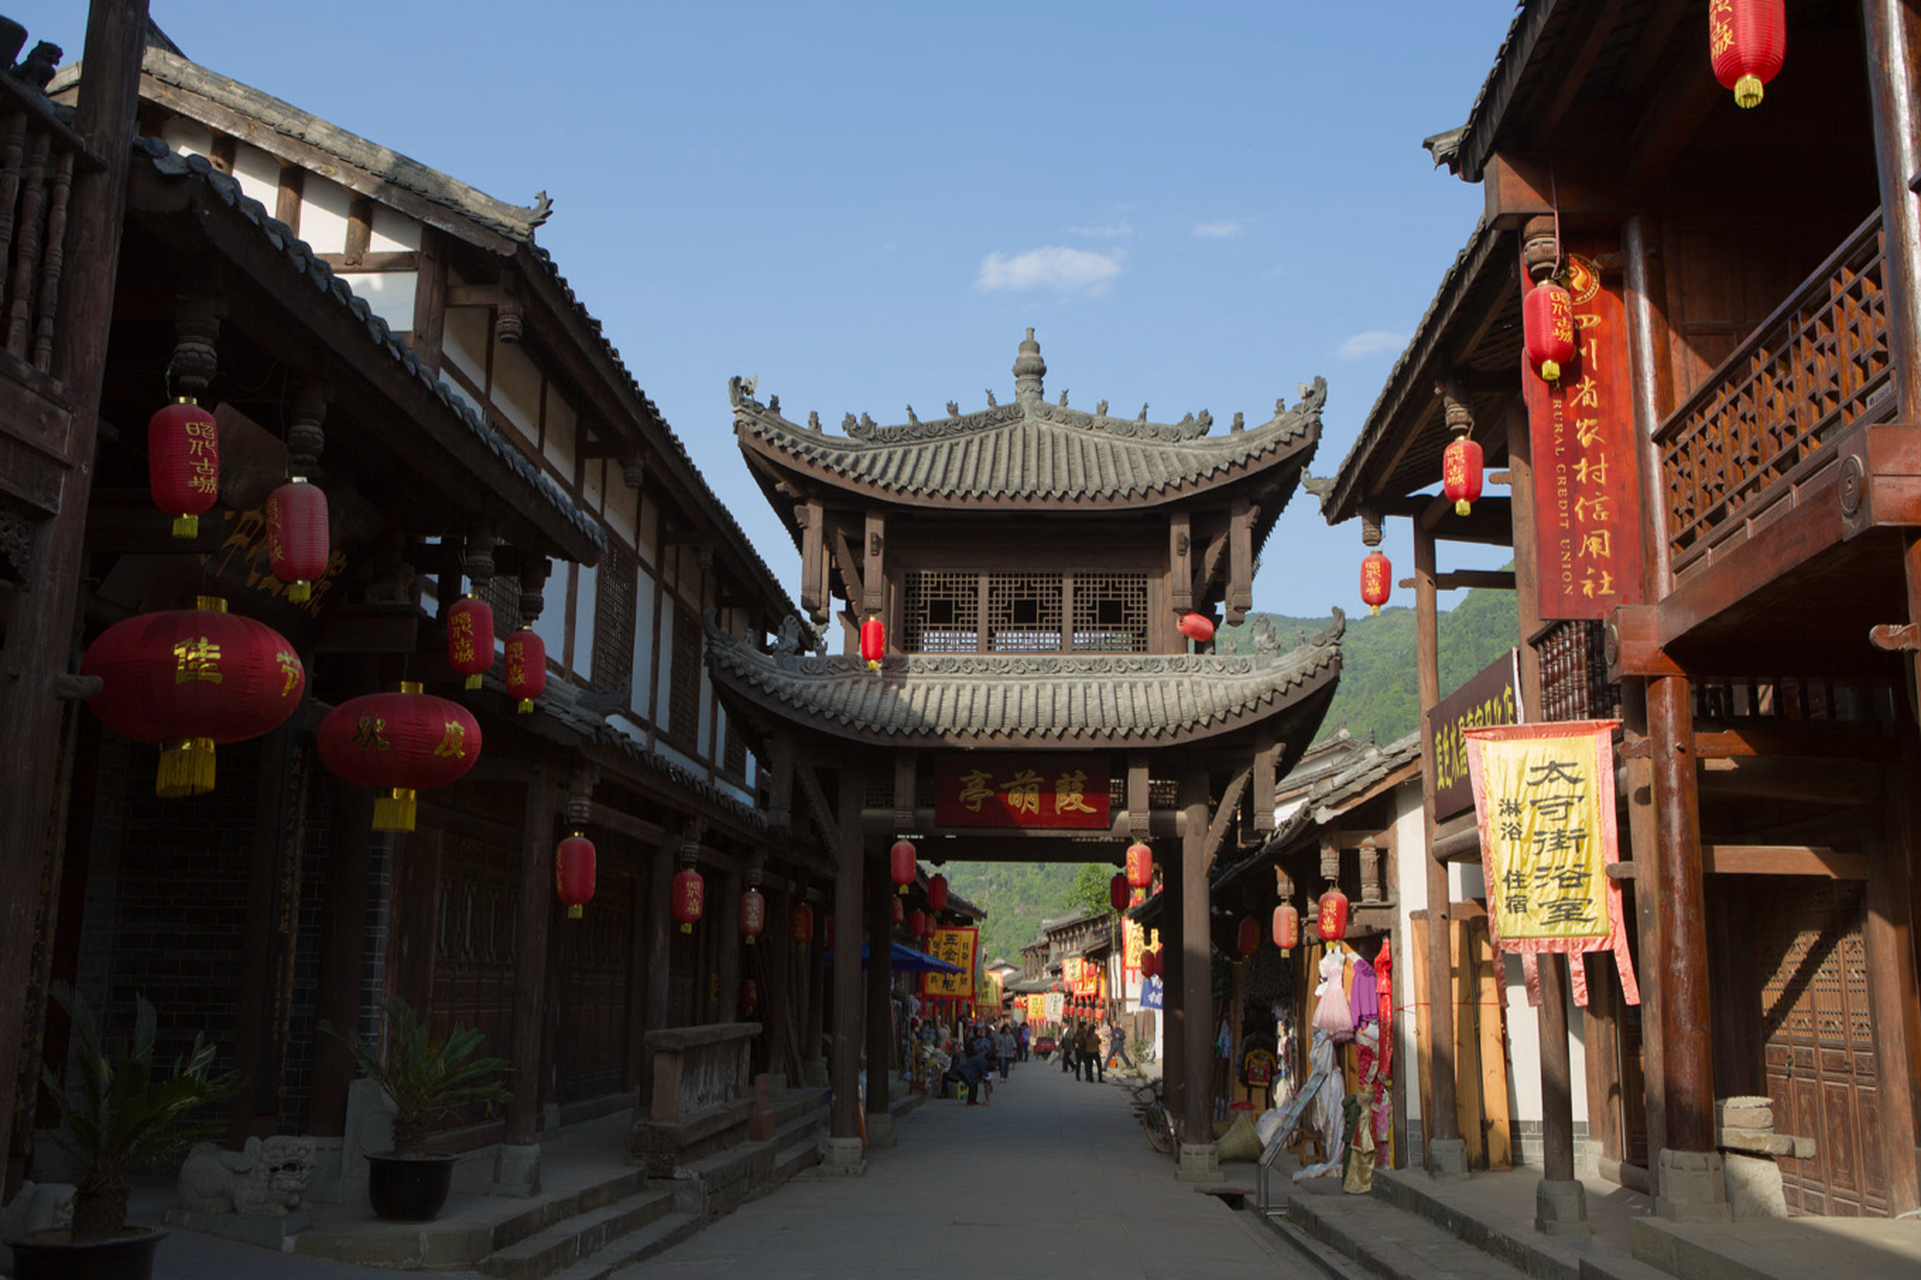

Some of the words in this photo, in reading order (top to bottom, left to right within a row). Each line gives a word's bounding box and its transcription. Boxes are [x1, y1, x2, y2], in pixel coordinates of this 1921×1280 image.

[1550, 292, 1572, 343] 昭化古城
[1552, 399, 1565, 456] RURAL
[185, 421, 216, 494] 昭化古城
[1447, 446, 1465, 486] 昭化古城
[1571, 314, 1615, 599] 四川省农村信用社
[1556, 464, 1569, 529] CREDIT
[1560, 539, 1573, 595] UNION
[451, 611, 475, 664] 昭化古城
[1499, 798, 1523, 841] 淋浴
[1527, 760, 1597, 926] 太守街浴室
[1503, 870, 1528, 914] 住宿
